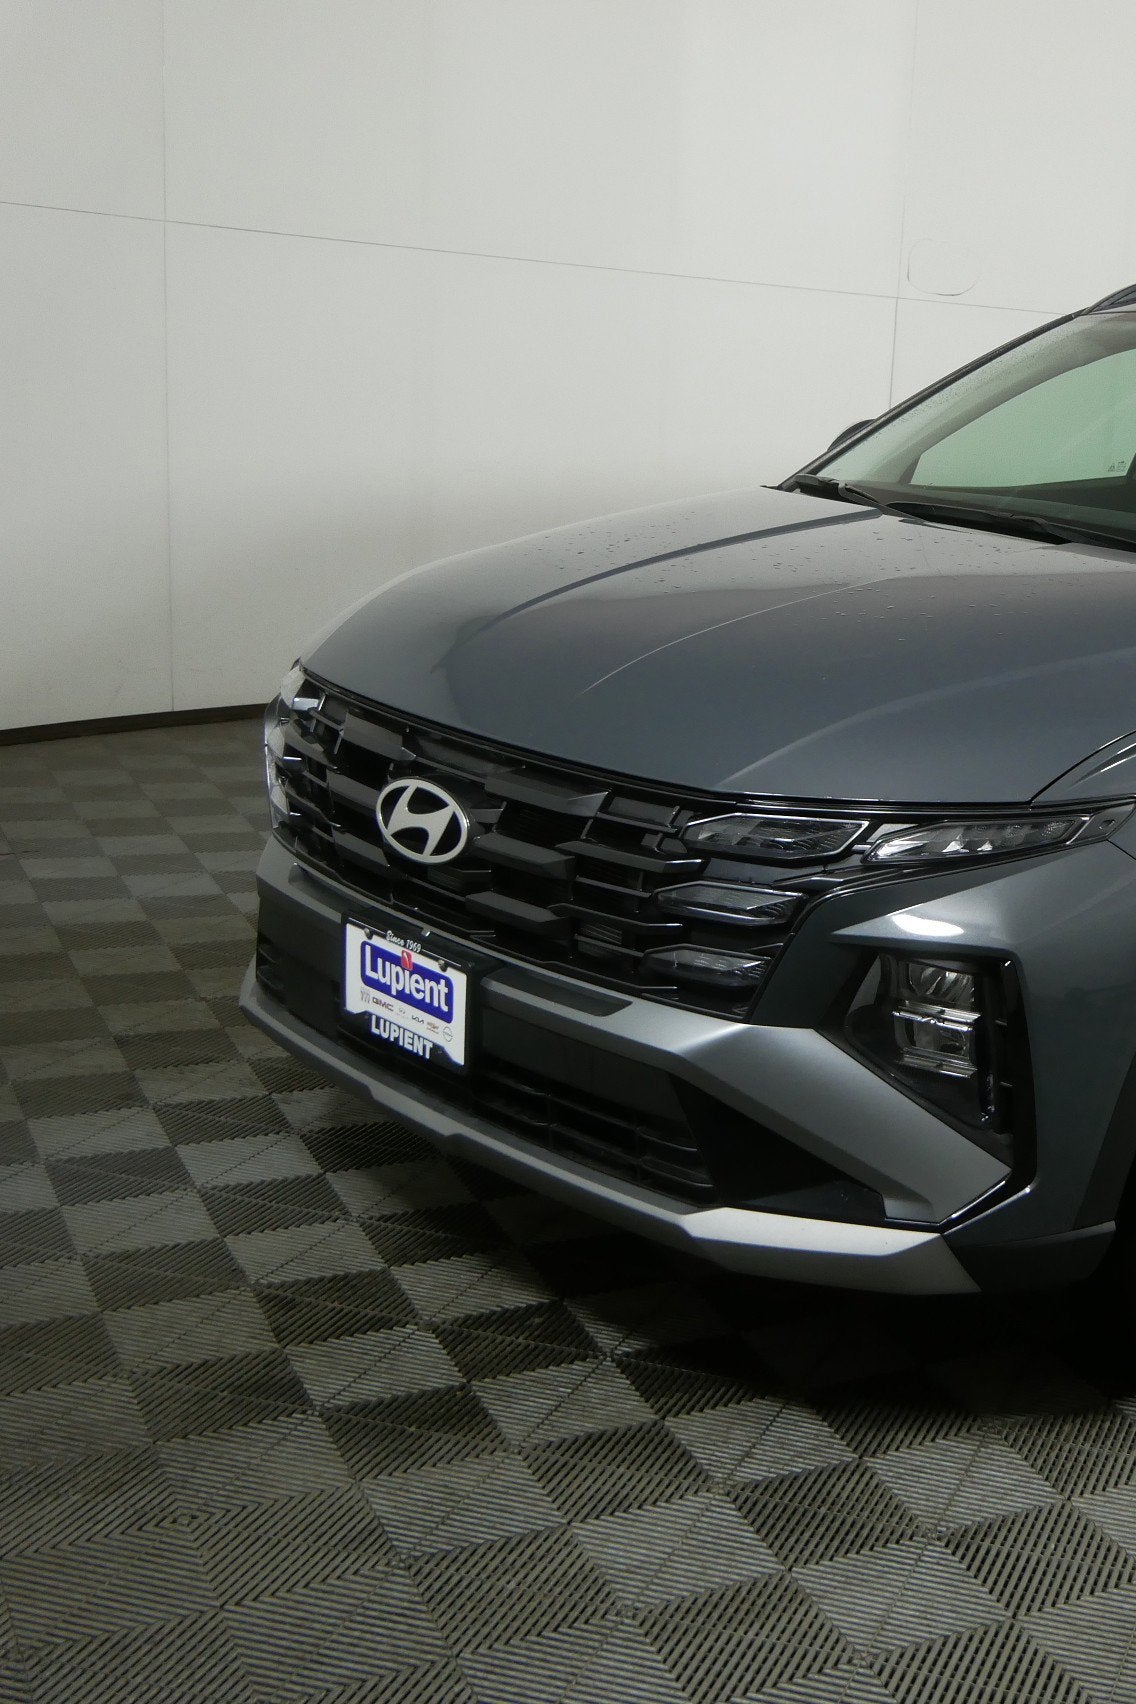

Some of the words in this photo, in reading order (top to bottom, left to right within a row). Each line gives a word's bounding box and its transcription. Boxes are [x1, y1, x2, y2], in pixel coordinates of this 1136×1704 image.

[386, 930, 404, 947] Since
[406, 939, 422, 953] 1969
[365, 944, 449, 1012] Lupient
[372, 996, 394, 1012] GMC
[371, 1014, 433, 1059] LUPIENT
